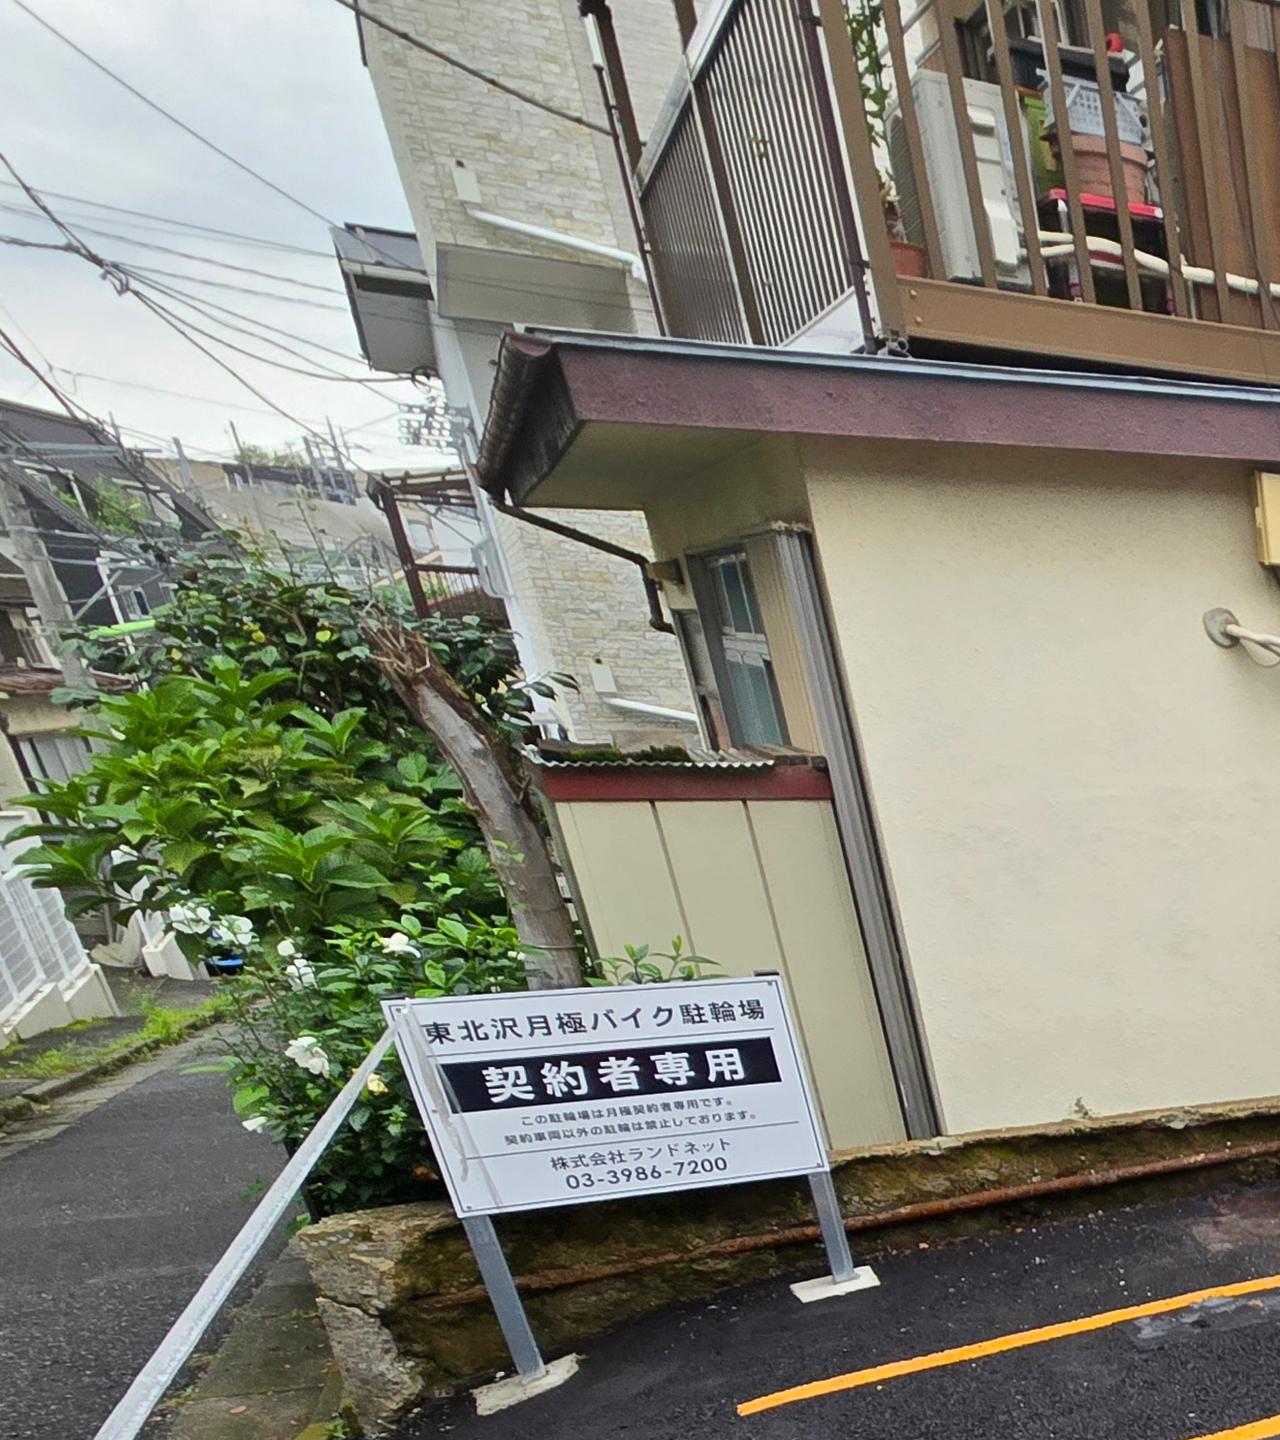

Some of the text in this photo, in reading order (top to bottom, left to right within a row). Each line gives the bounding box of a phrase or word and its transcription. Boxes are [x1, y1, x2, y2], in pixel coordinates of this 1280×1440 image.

[422, 999, 765, 1045] 東北沢月極バイク駐輪場
[481, 1048, 745, 1104] 契約者専用
[504, 1109, 757, 1146] 契約車両以外の駐輪は禁止しております。
[521, 1096, 733, 1127] この駐輪場は月極契約者専用です。
[550, 1137, 731, 1172] 株式会社ランドネット
[565, 1156, 728, 1190] 03-3986-7200
